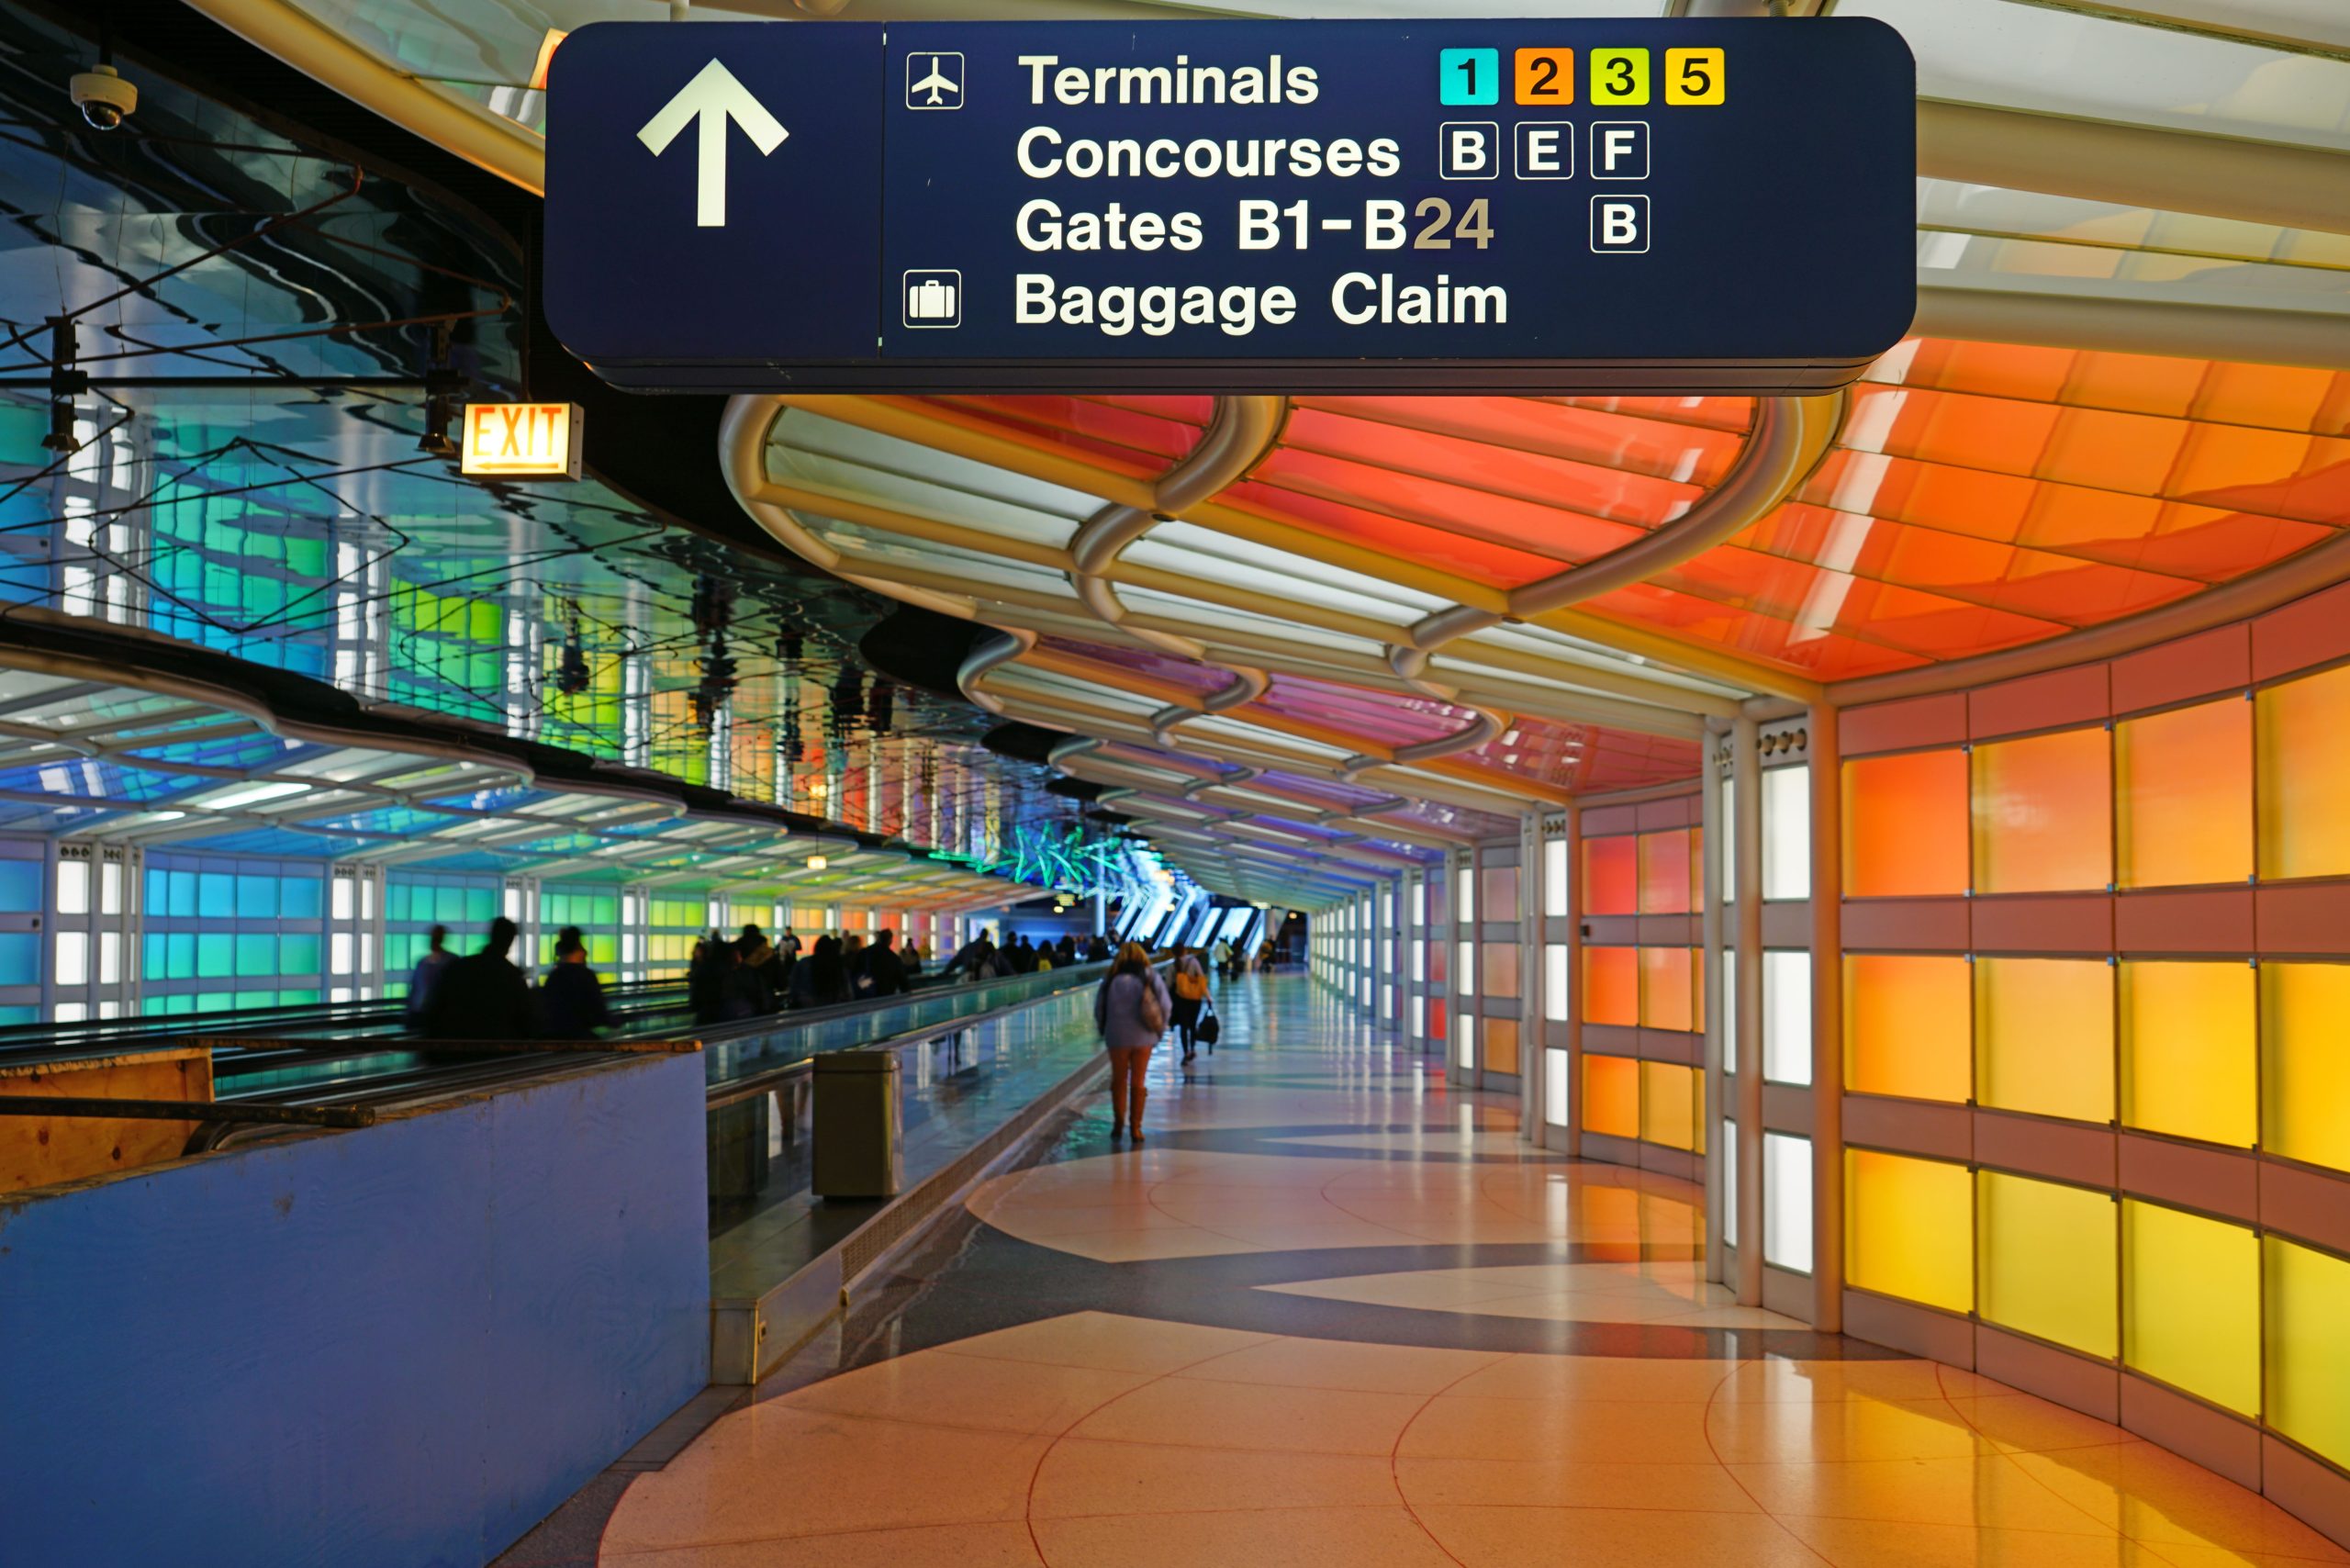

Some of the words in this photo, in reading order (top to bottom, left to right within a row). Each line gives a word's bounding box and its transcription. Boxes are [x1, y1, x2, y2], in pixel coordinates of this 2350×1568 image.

[1018, 54, 1319, 106] Terminals
[1457, 58, 1476, 95] 1
[1529, 57, 1560, 95] 2
[1605, 57, 1636, 96] 3
[1680, 58, 1711, 96] 5
[1016, 126, 1401, 179] Concourses
[1451, 130, 1486, 171] B
[1528, 130, 1561, 171] E
[1605, 130, 1636, 171] F
[1015, 198, 1203, 252] Gates
[1603, 204, 1638, 244] B
[1015, 274, 1297, 337] Baggage
[1331, 272, 1507, 325] Claim
[473, 407, 562, 456] EXIT
